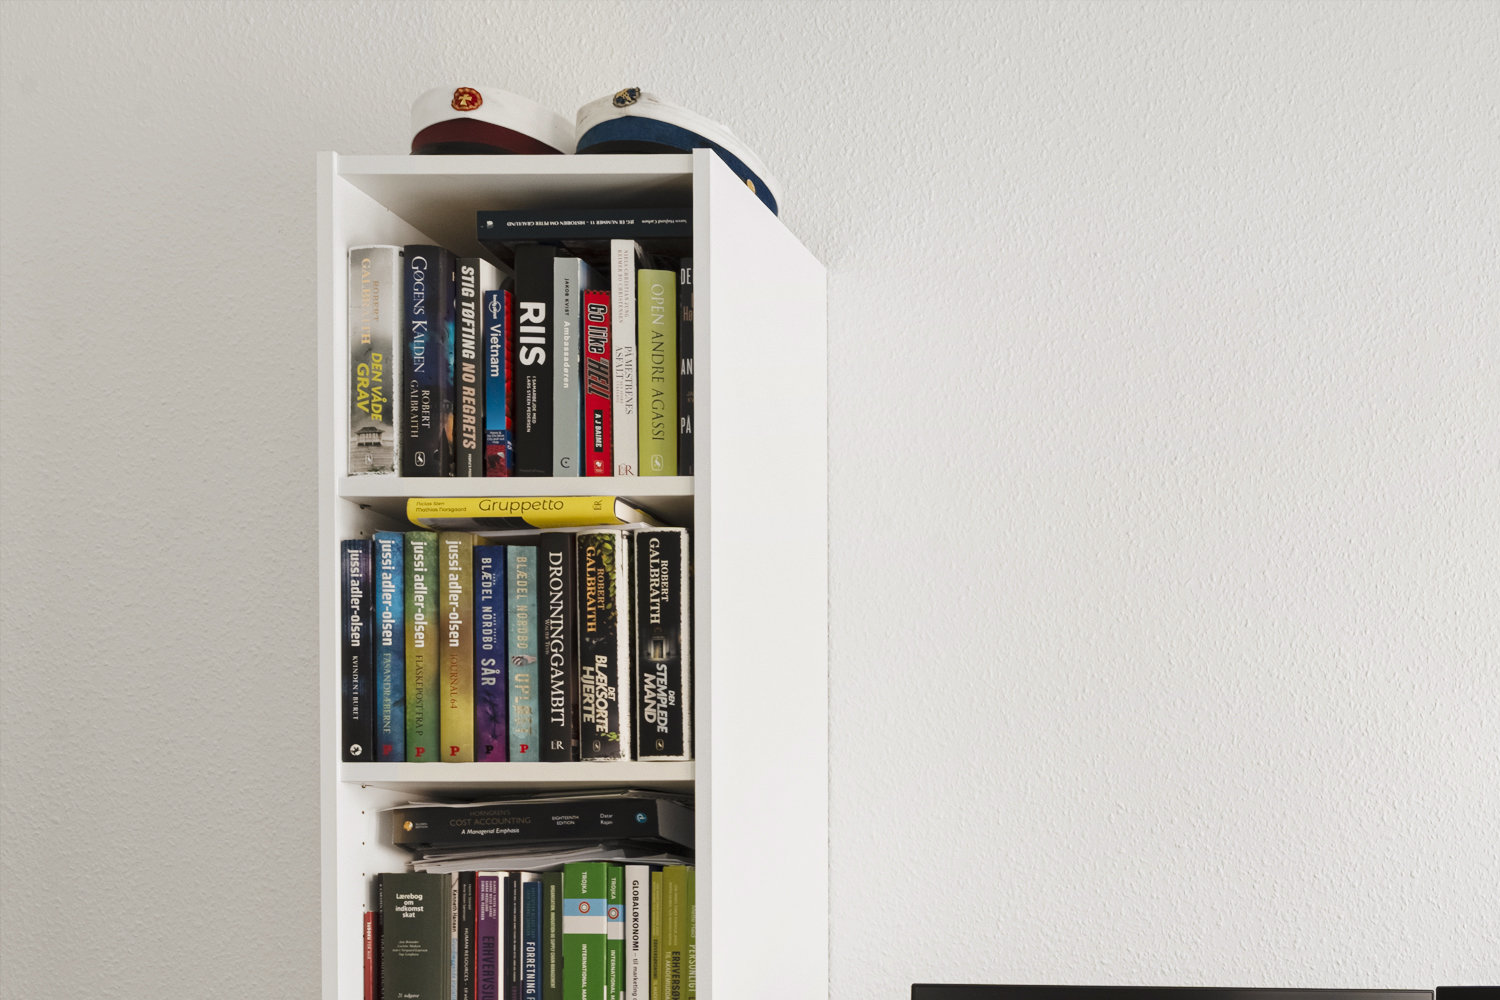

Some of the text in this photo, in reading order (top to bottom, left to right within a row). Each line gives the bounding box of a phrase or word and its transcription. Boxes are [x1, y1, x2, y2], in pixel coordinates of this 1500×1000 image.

[461, 266, 476, 449] STIG TØFTING NO REGRETS
[490, 324, 501, 377] Vietnam
[519, 302, 546, 366] RIIS
[587, 303, 609, 400] Go like HELL
[357, 363, 369, 413] GRAV
[372, 353, 387, 421] DEN VÅDE
[615, 346, 624, 380] ASFALT
[651, 284, 664, 441] OPEN ANDRE AGASSI
[410, 380, 418, 437] GALBRAITH
[421, 390, 430, 428] ROBERT
[479, 499, 564, 514] Gruppetto
[347, 549, 362, 577] jussi
[379, 539, 394, 570] jussi
[411, 541, 427, 572] jussi
[481, 557, 492, 601] BLÆDEL
[649, 537, 660, 624] GALBRAITH
[661, 560, 669, 602] ROBERT
[350, 580, 362, 647] adler-olsen
[381, 572, 395, 646] adler-olsen
[413, 575, 427, 648] adler-olsen
[516, 556, 528, 649] BLÆDEL NORDBO
[586, 546, 597, 632] GALBRAITH
[597, 568, 605, 610] ROBERT
[446, 540, 462, 709] jussi adler-olsen JOURNAL 64
[482, 606, 493, 650] NORDBO
[549, 551, 565, 726] DRONNINGGAMBIT
[415, 655, 424, 710] FLASKEPOST
[481, 658, 500, 686] SÅR
[581, 666, 595, 723] HJERTE
[595, 655, 608, 733] BLÆKSORTE
[607, 687, 616, 701] DET
[644, 673, 657, 723] MAND
[656, 663, 668, 733] STEMPLEDE
[449, 817, 532, 827] COST ACCOUNTING
[396, 893, 423, 901] Lærebog
[631, 880, 639, 951] GLOBALØKONOMI
[526, 942, 535, 994] FORRETNING
[631, 966, 639, 997] marketing
